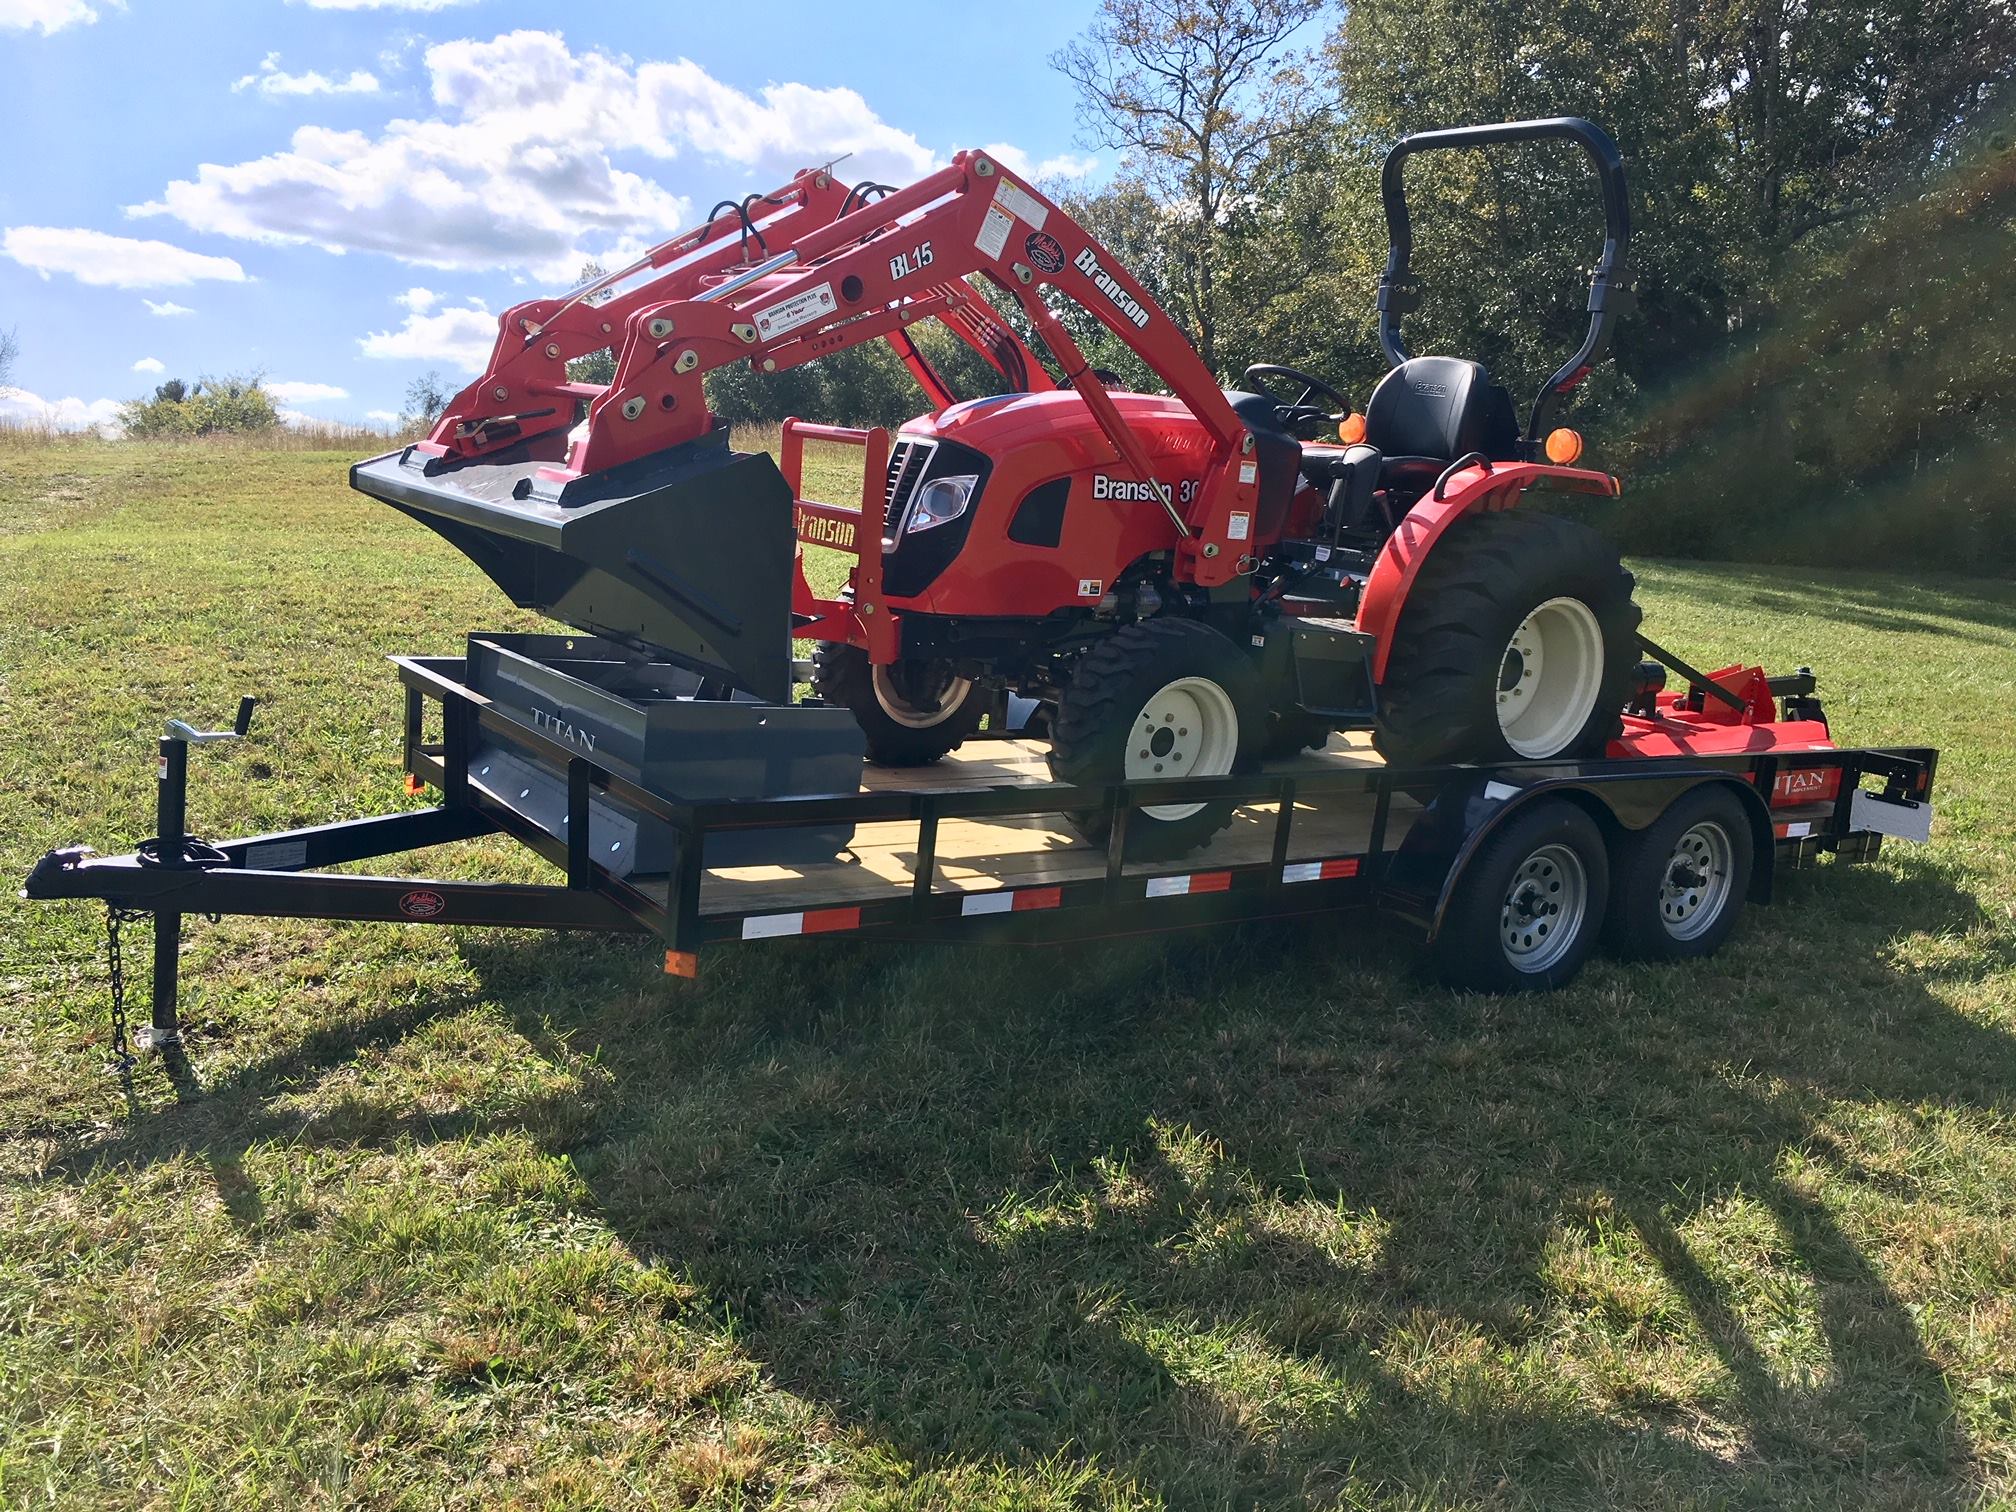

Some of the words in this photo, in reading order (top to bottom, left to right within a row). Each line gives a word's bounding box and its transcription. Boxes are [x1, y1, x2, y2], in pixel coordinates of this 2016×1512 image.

[889, 241, 934, 281] BL15
[768, 305, 786, 318] BRANSON
[785, 298, 807, 311] PROTECTION
[807, 293, 817, 302] PLUS
[1073, 247, 1150, 329] Branson
[791, 307, 805, 317] Year
[797, 507, 856, 547] ranson
[531, 707, 596, 752] TITAN
[1773, 771, 1824, 795] ITAN
